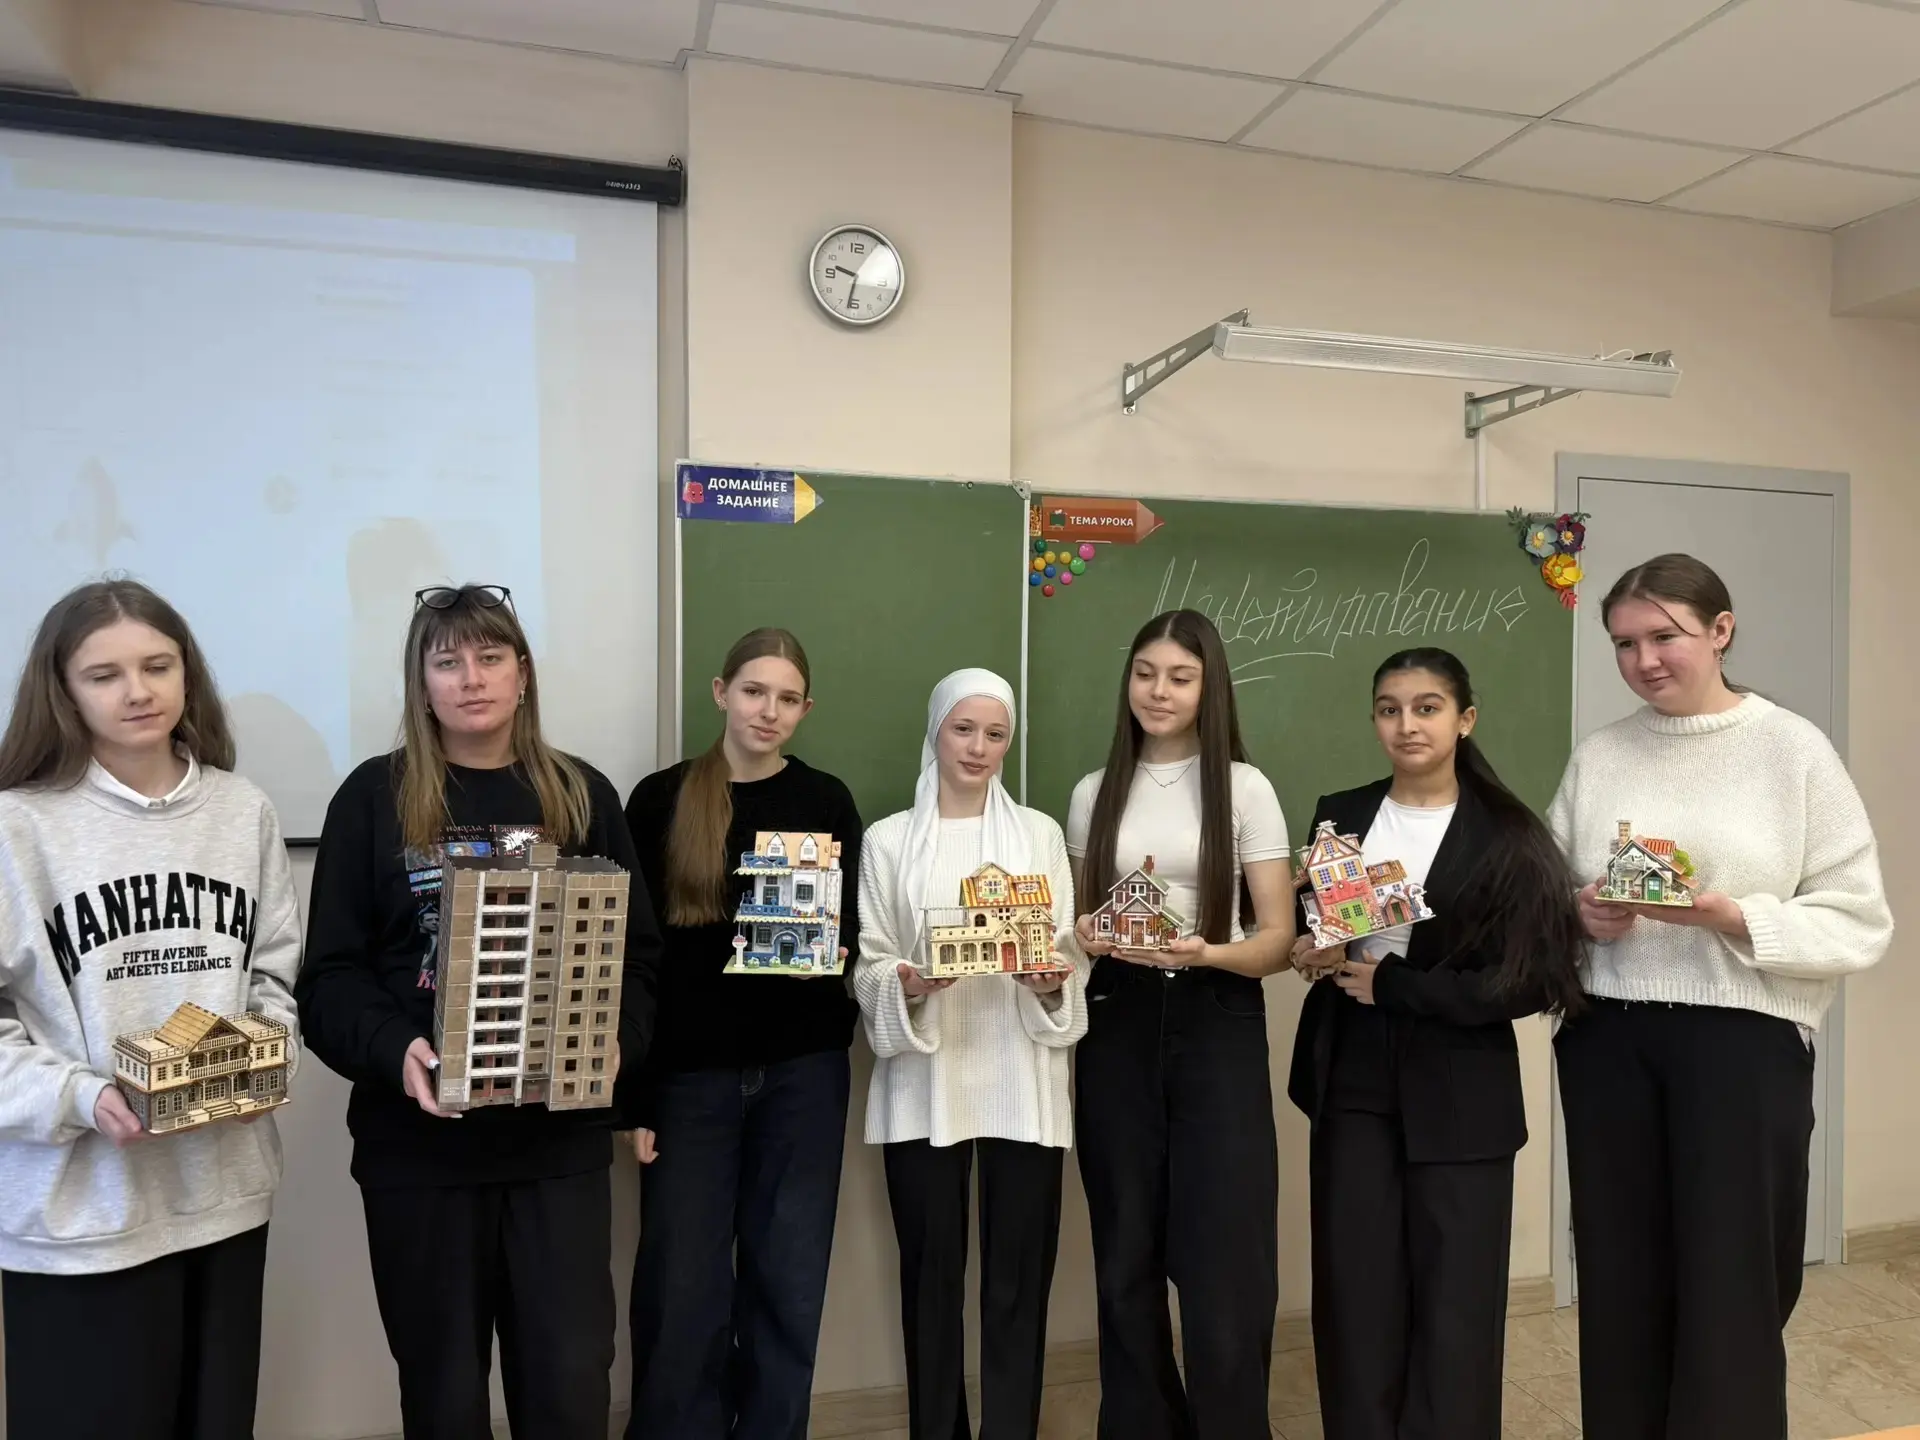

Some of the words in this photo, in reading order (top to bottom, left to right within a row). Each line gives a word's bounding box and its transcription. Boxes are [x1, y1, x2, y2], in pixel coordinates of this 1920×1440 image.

[850, 242, 865, 255] 12
[825, 268, 836, 279] 9
[876, 293, 883, 301] 4
[848, 298, 860, 310] 6
[707, 477, 788, 493] ДОМАШНЕЕ
[716, 494, 780, 509] ЗАДАНИЕ
[1070, 516, 1098, 526] ТЕМА
[1100, 517, 1134, 527] УРОКА
[122, 949, 160, 964] FIFTH
[162, 945, 208, 961] AVENUE
[106, 967, 125, 981] ART
[126, 963, 169, 978] MEETS
[170, 957, 232, 974] ELEGANCE
